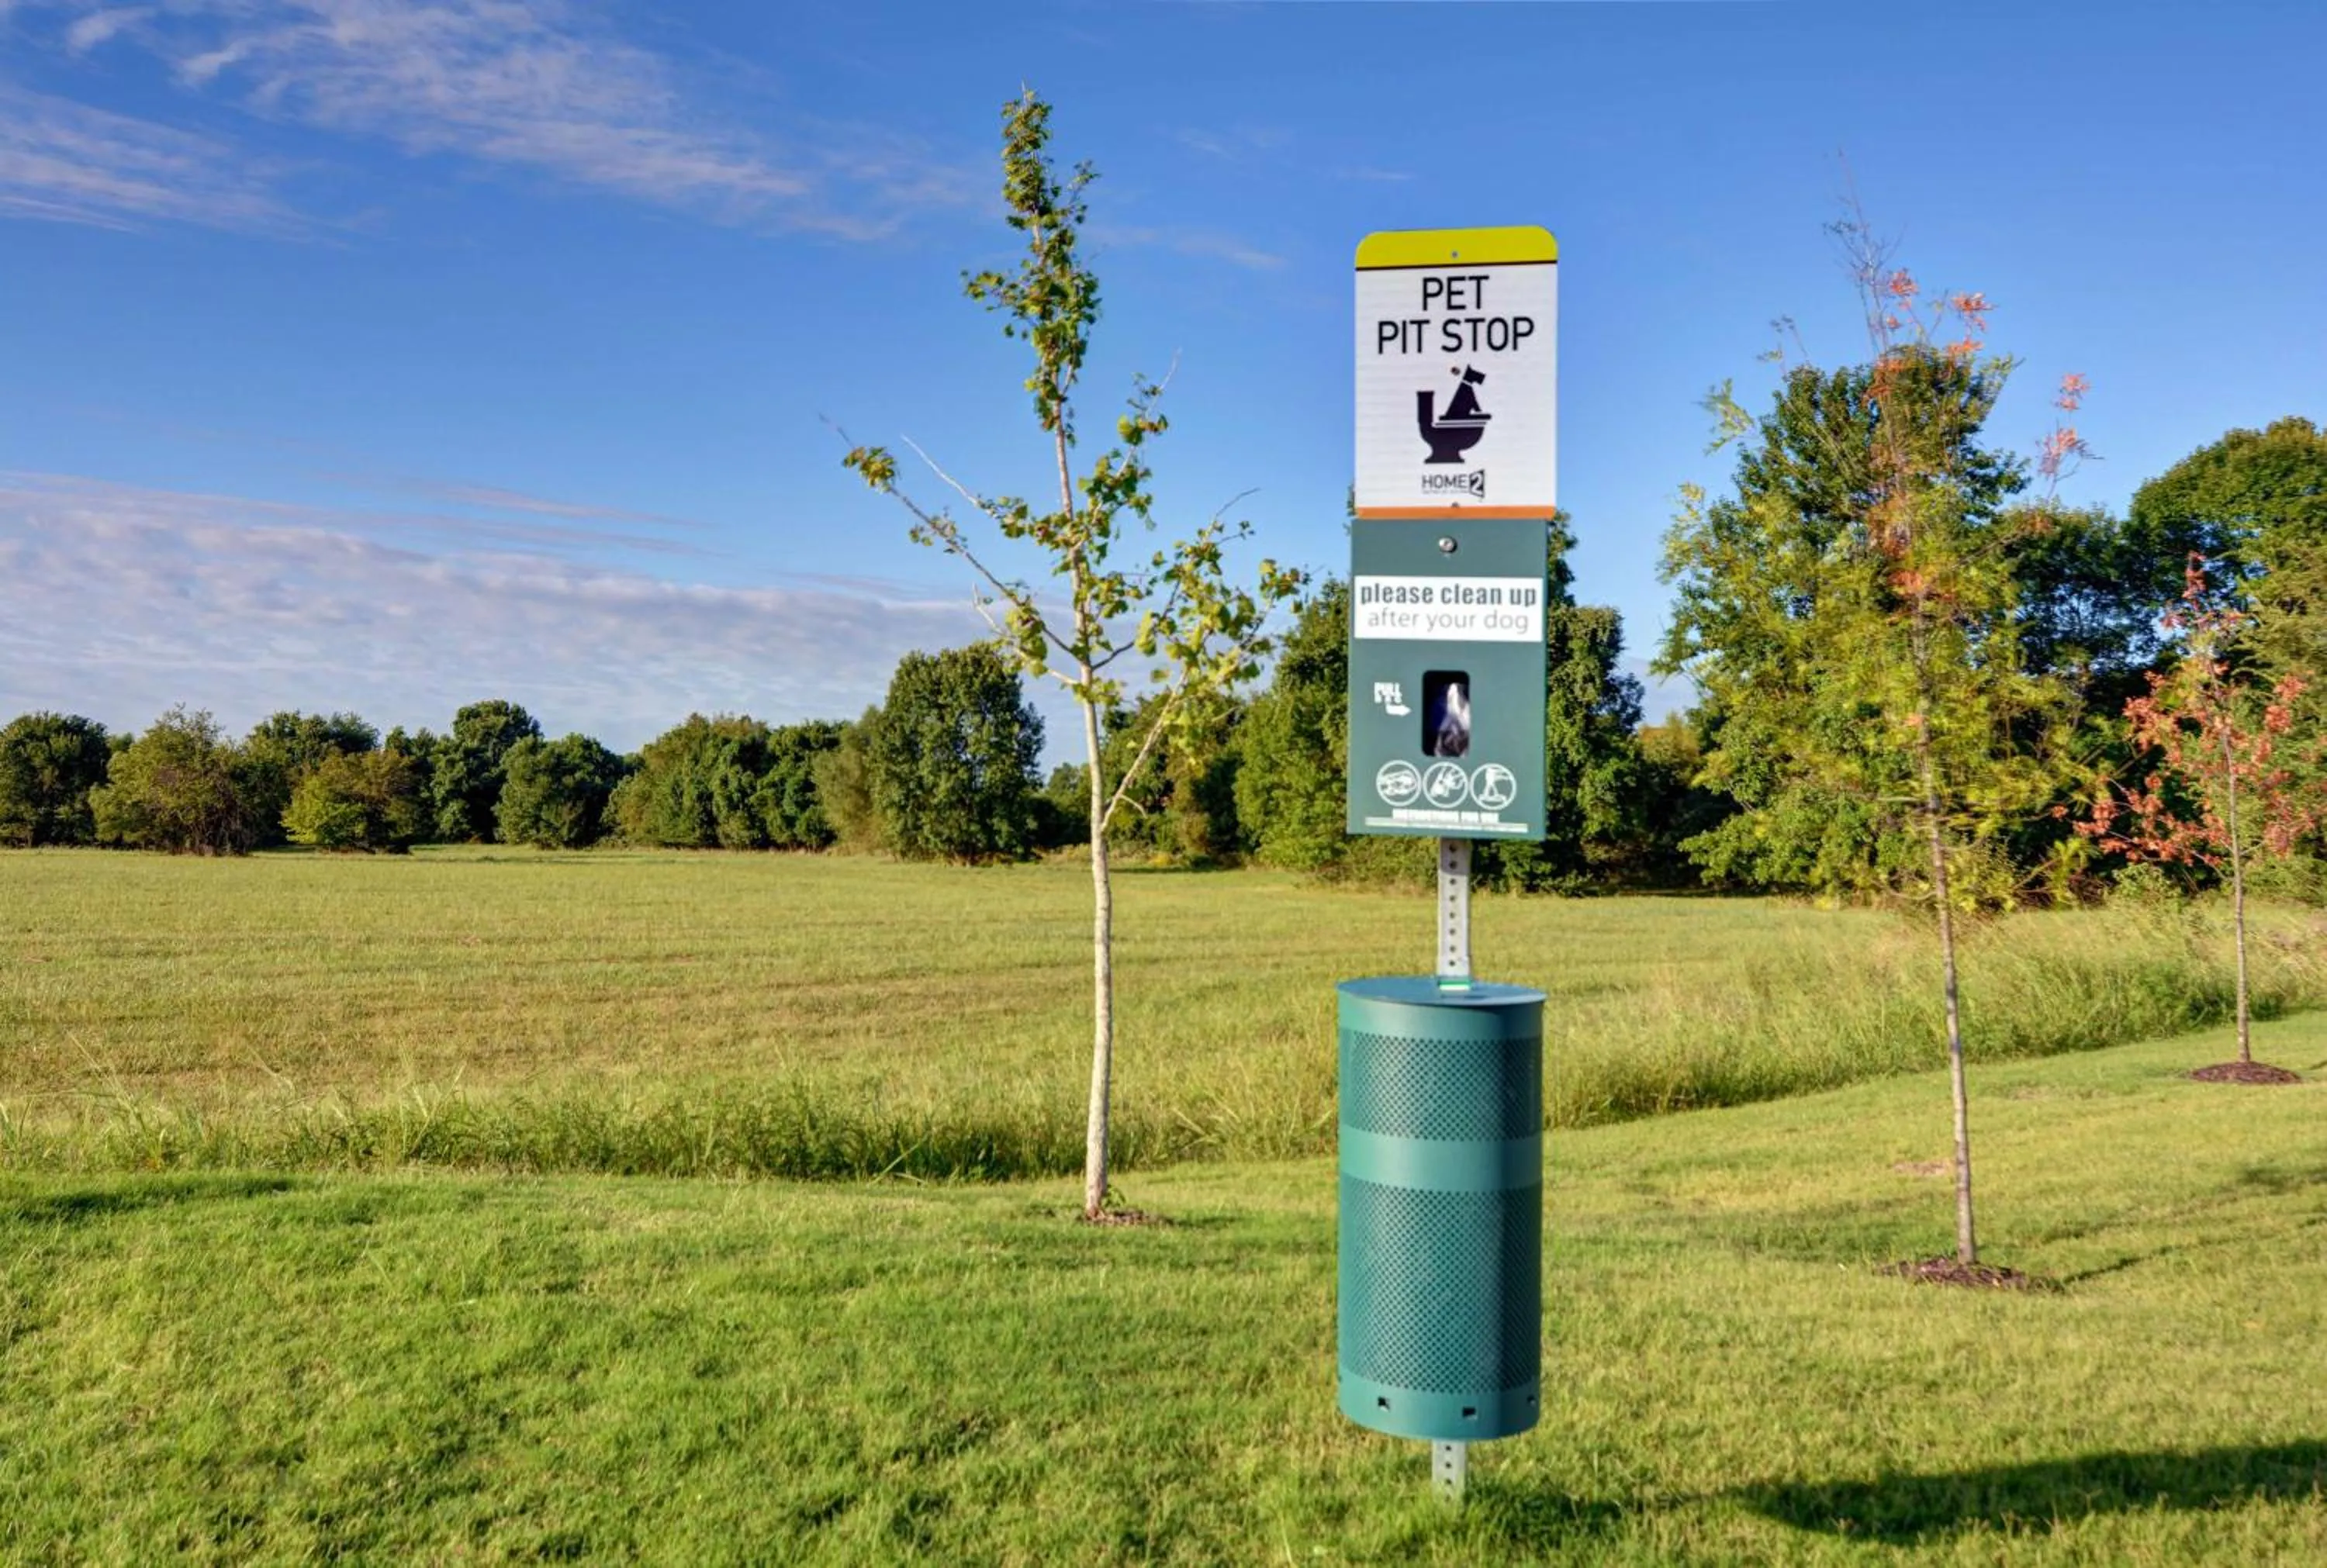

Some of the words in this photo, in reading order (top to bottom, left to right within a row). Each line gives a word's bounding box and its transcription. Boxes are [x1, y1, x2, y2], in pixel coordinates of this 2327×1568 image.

[1422, 275, 1490, 311] PET
[1378, 319, 1431, 354] PIT
[1440, 316, 1535, 353] STOP
[1361, 583, 1433, 605] please
[1440, 583, 1502, 606] clean
[1509, 587, 1537, 607] up
[1368, 607, 1419, 627] after
[1426, 612, 1476, 633] your
[1483, 610, 1529, 635] dog
